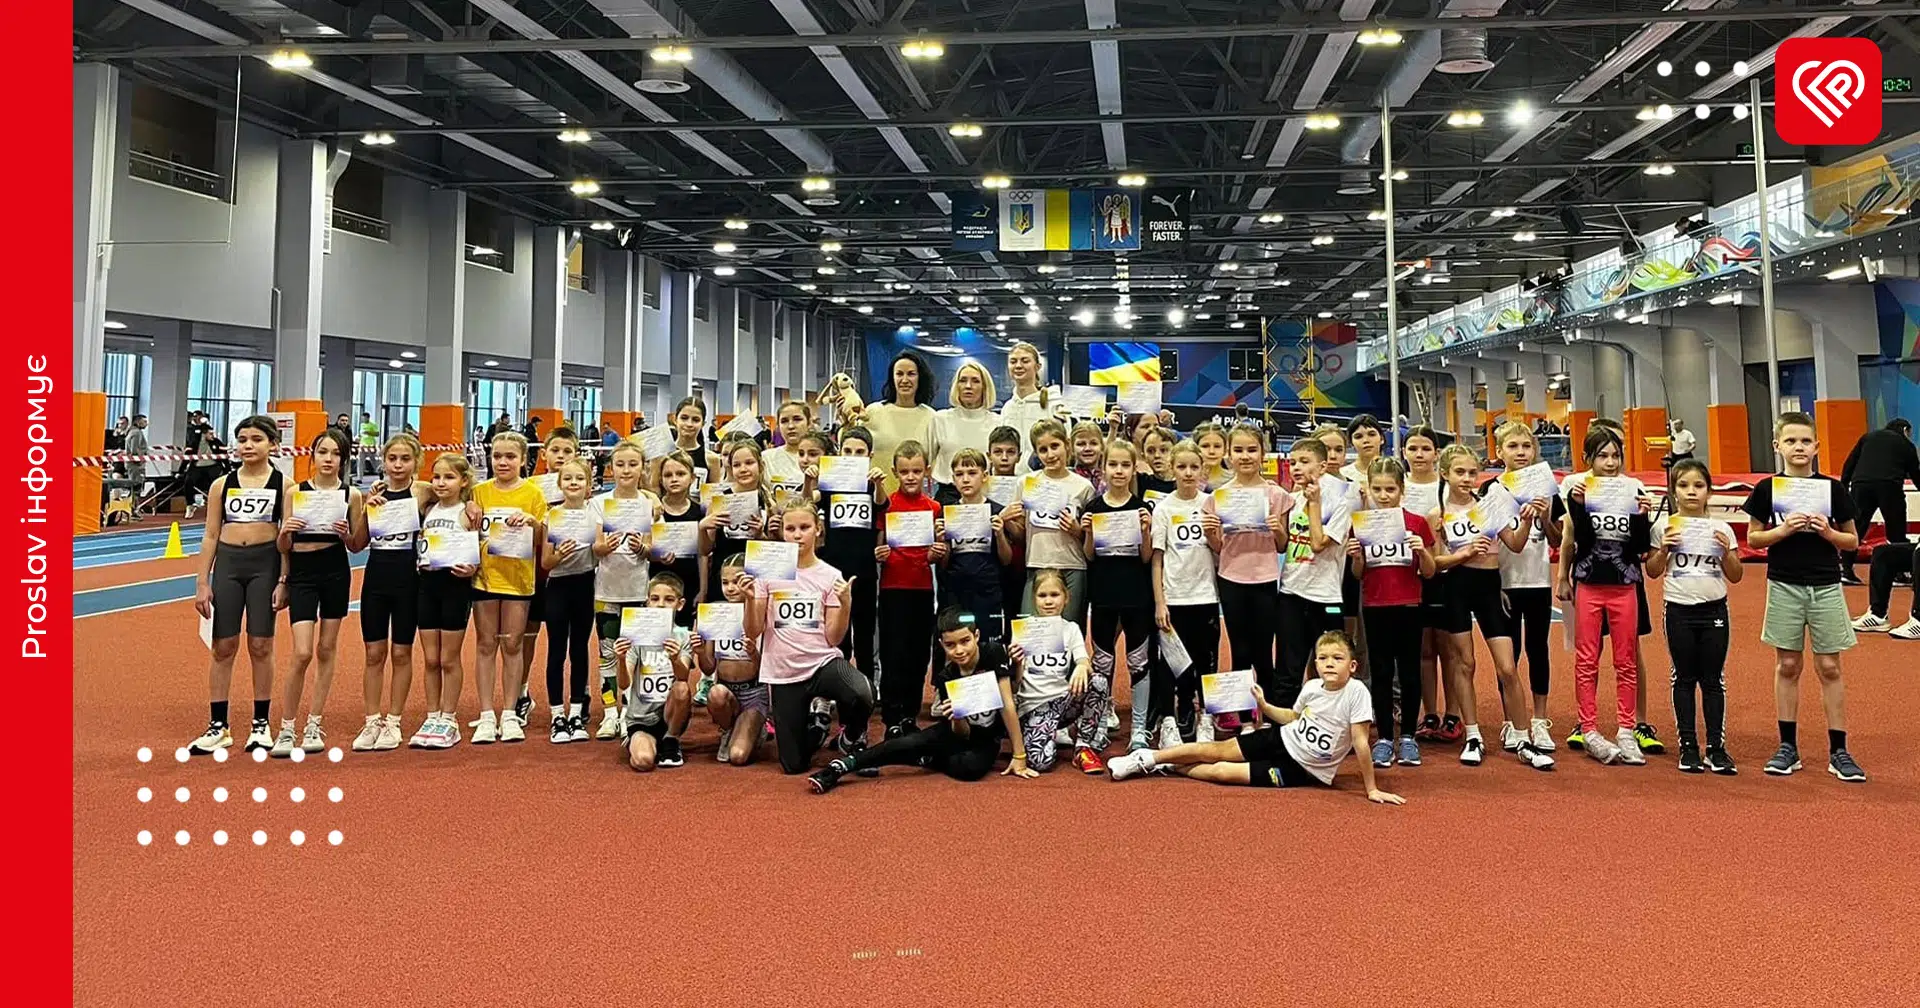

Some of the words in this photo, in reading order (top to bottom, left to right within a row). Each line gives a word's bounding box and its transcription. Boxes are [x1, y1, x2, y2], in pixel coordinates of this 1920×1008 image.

[1883, 79, 1911, 92] 10:24
[1149, 220, 1186, 231] FOREVER.
[1152, 231, 1184, 242] FASTER.
[229, 498, 270, 514] 057
[833, 504, 870, 520] 078
[1452, 520, 1480, 537] 06
[1590, 515, 1629, 533] 088
[1176, 524, 1202, 541] 09
[1675, 552, 1718, 569] 074
[778, 602, 814, 620] 081
[719, 639, 745, 651] 06
[1297, 717, 1333, 751] 066
